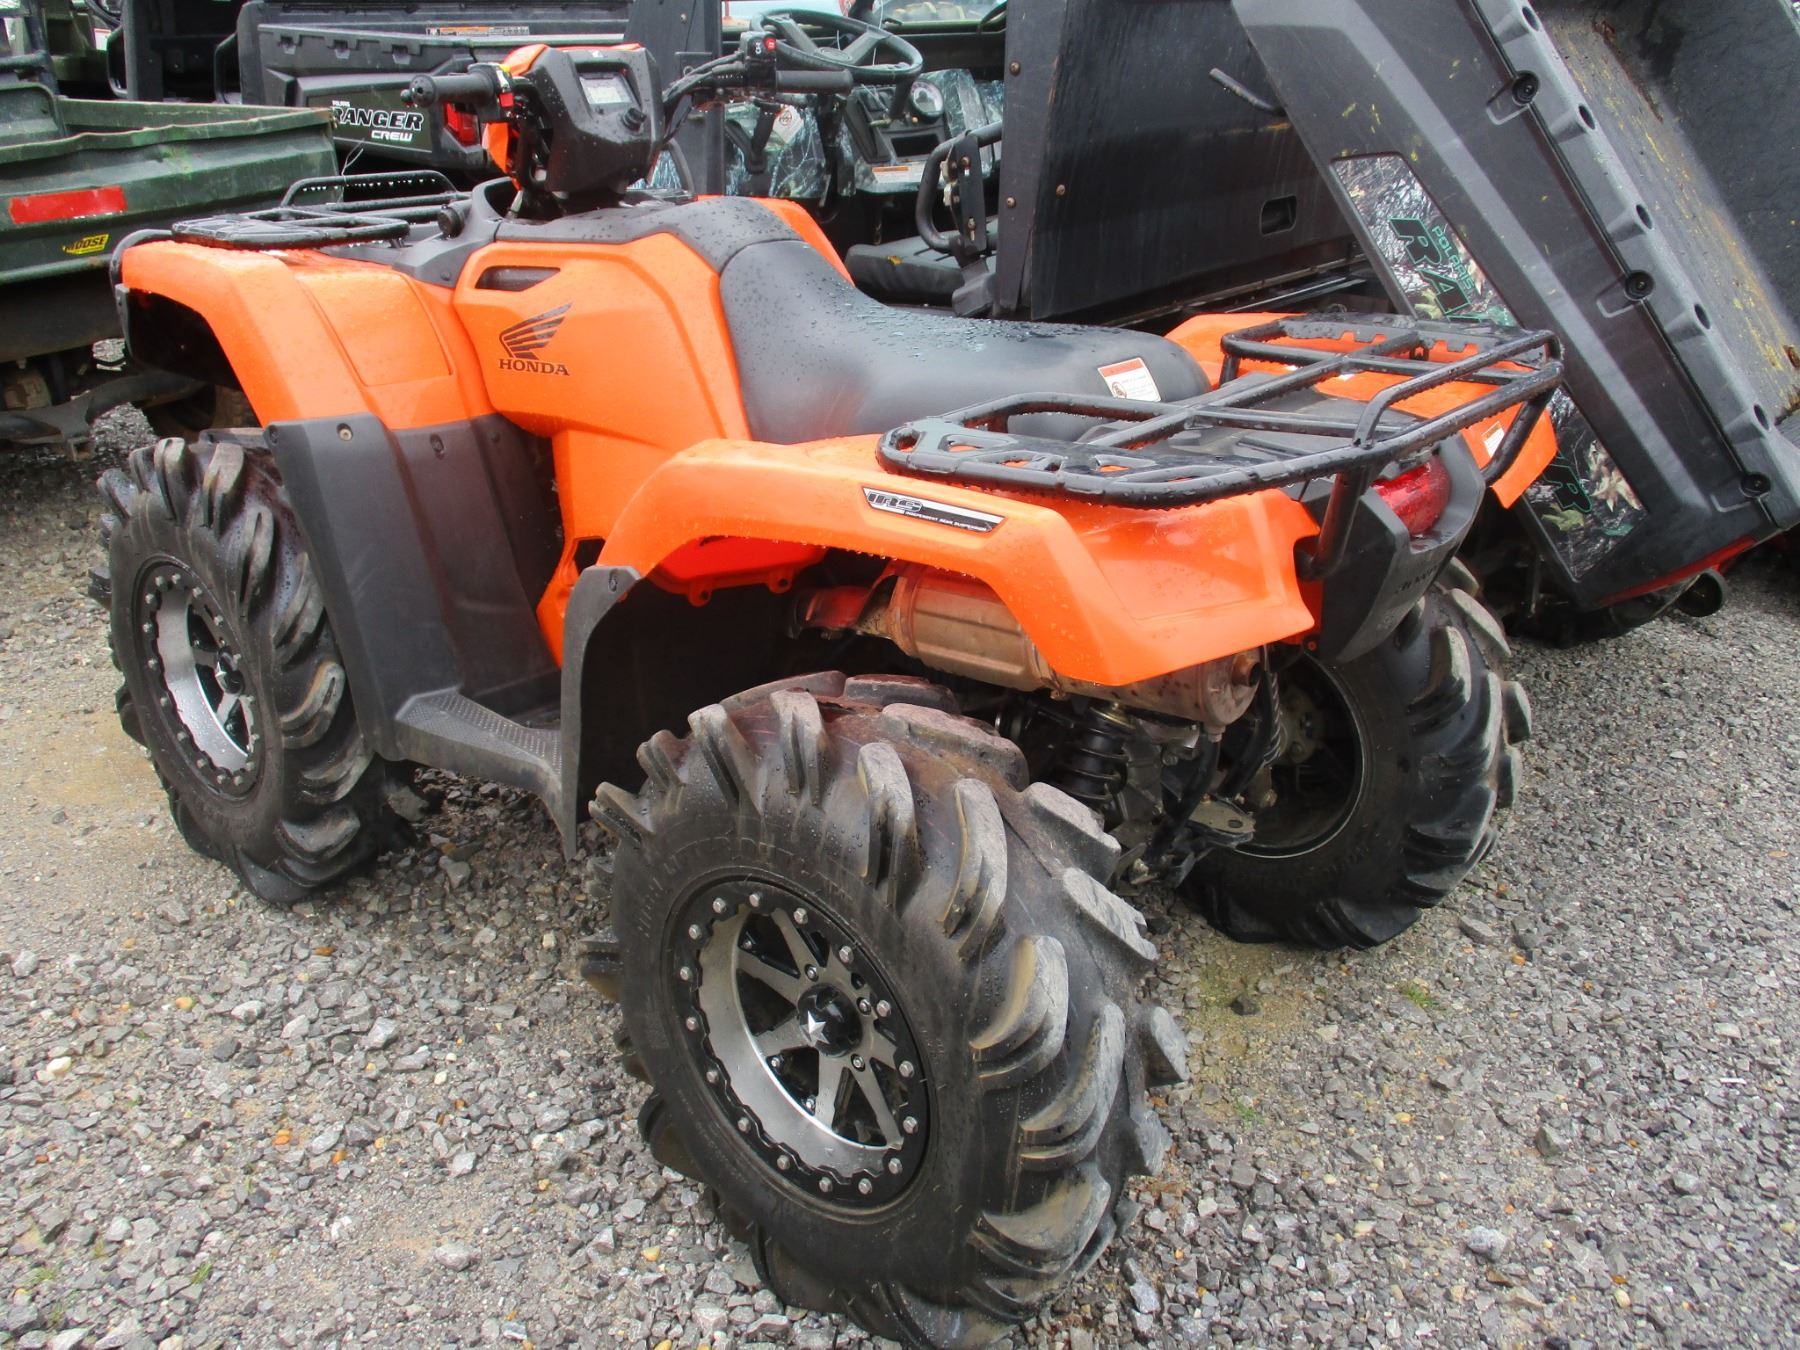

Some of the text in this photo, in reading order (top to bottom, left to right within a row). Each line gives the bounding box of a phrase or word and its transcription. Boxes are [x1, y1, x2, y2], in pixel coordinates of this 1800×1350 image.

[371, 130, 413, 142] CREW
[1432, 226, 1475, 290] POLARIS
[499, 358, 570, 376] HONDA
[867, 490, 923, 512] IRS
